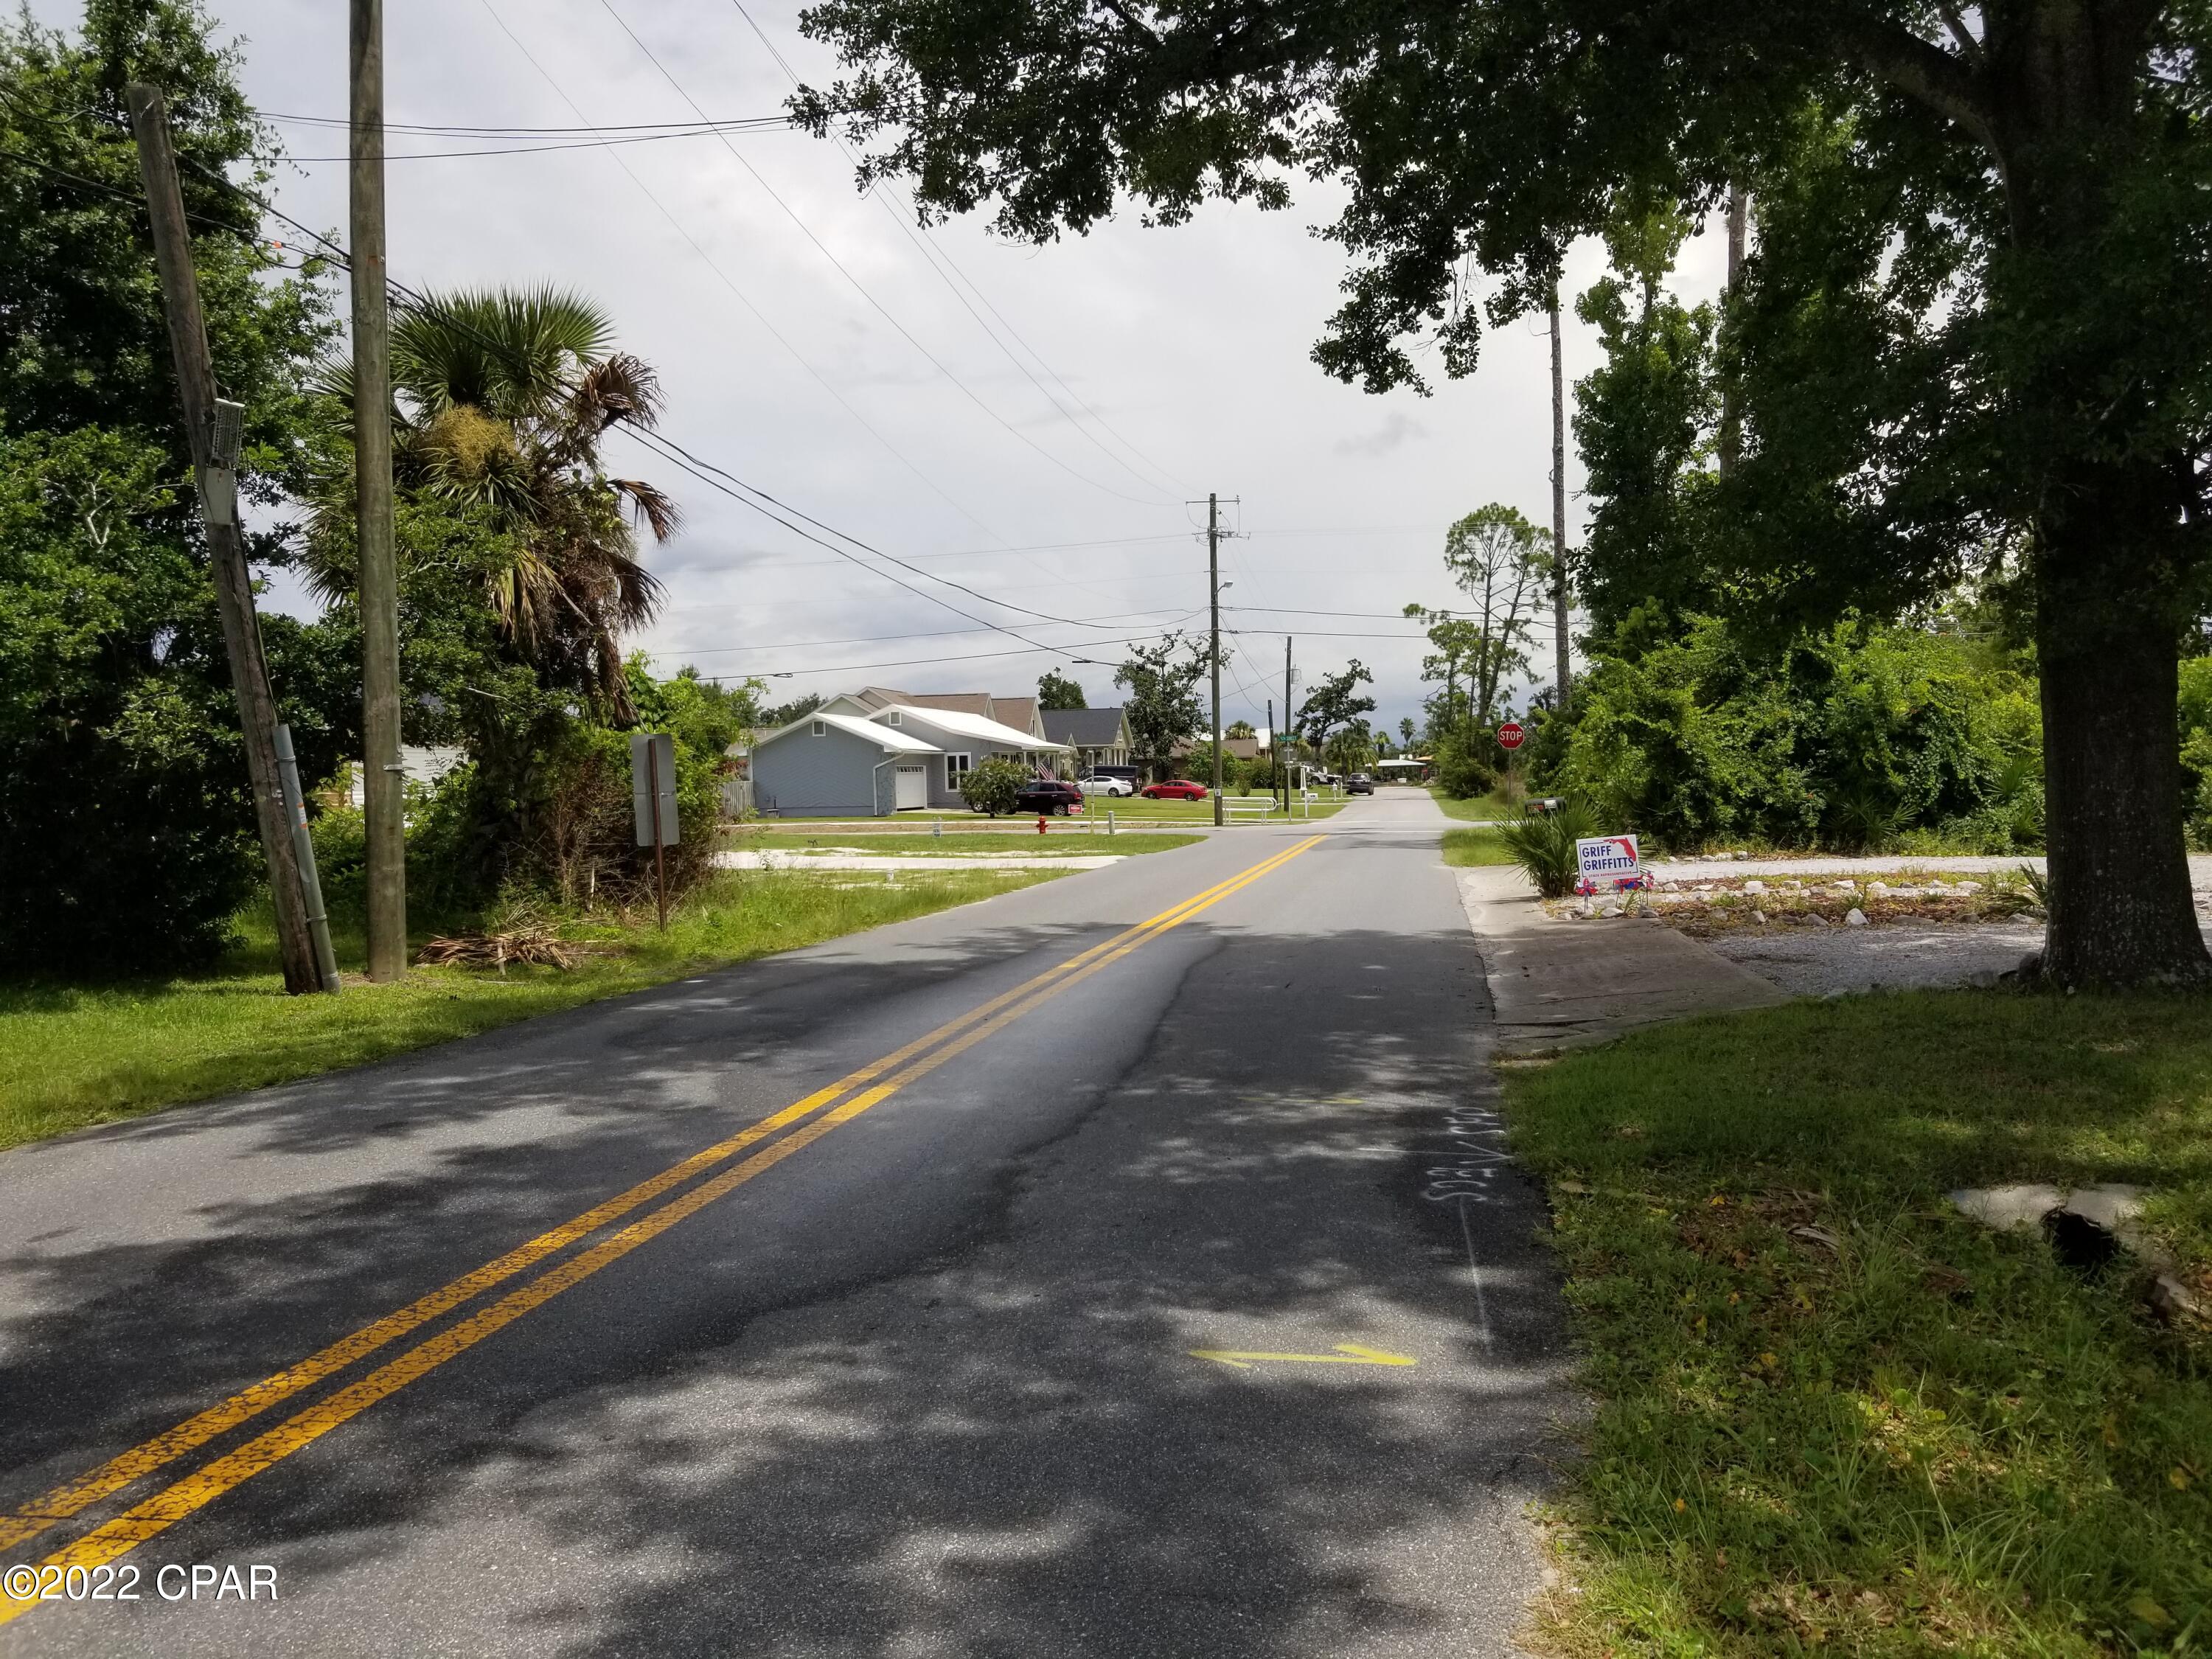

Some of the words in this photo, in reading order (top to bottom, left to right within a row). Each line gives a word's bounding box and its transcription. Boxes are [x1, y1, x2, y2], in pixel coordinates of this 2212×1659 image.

[1499, 731, 1523, 741] STOP
[1582, 845, 1611, 858] GRIFF
[1583, 856, 1634, 871] GRIFFITTS
